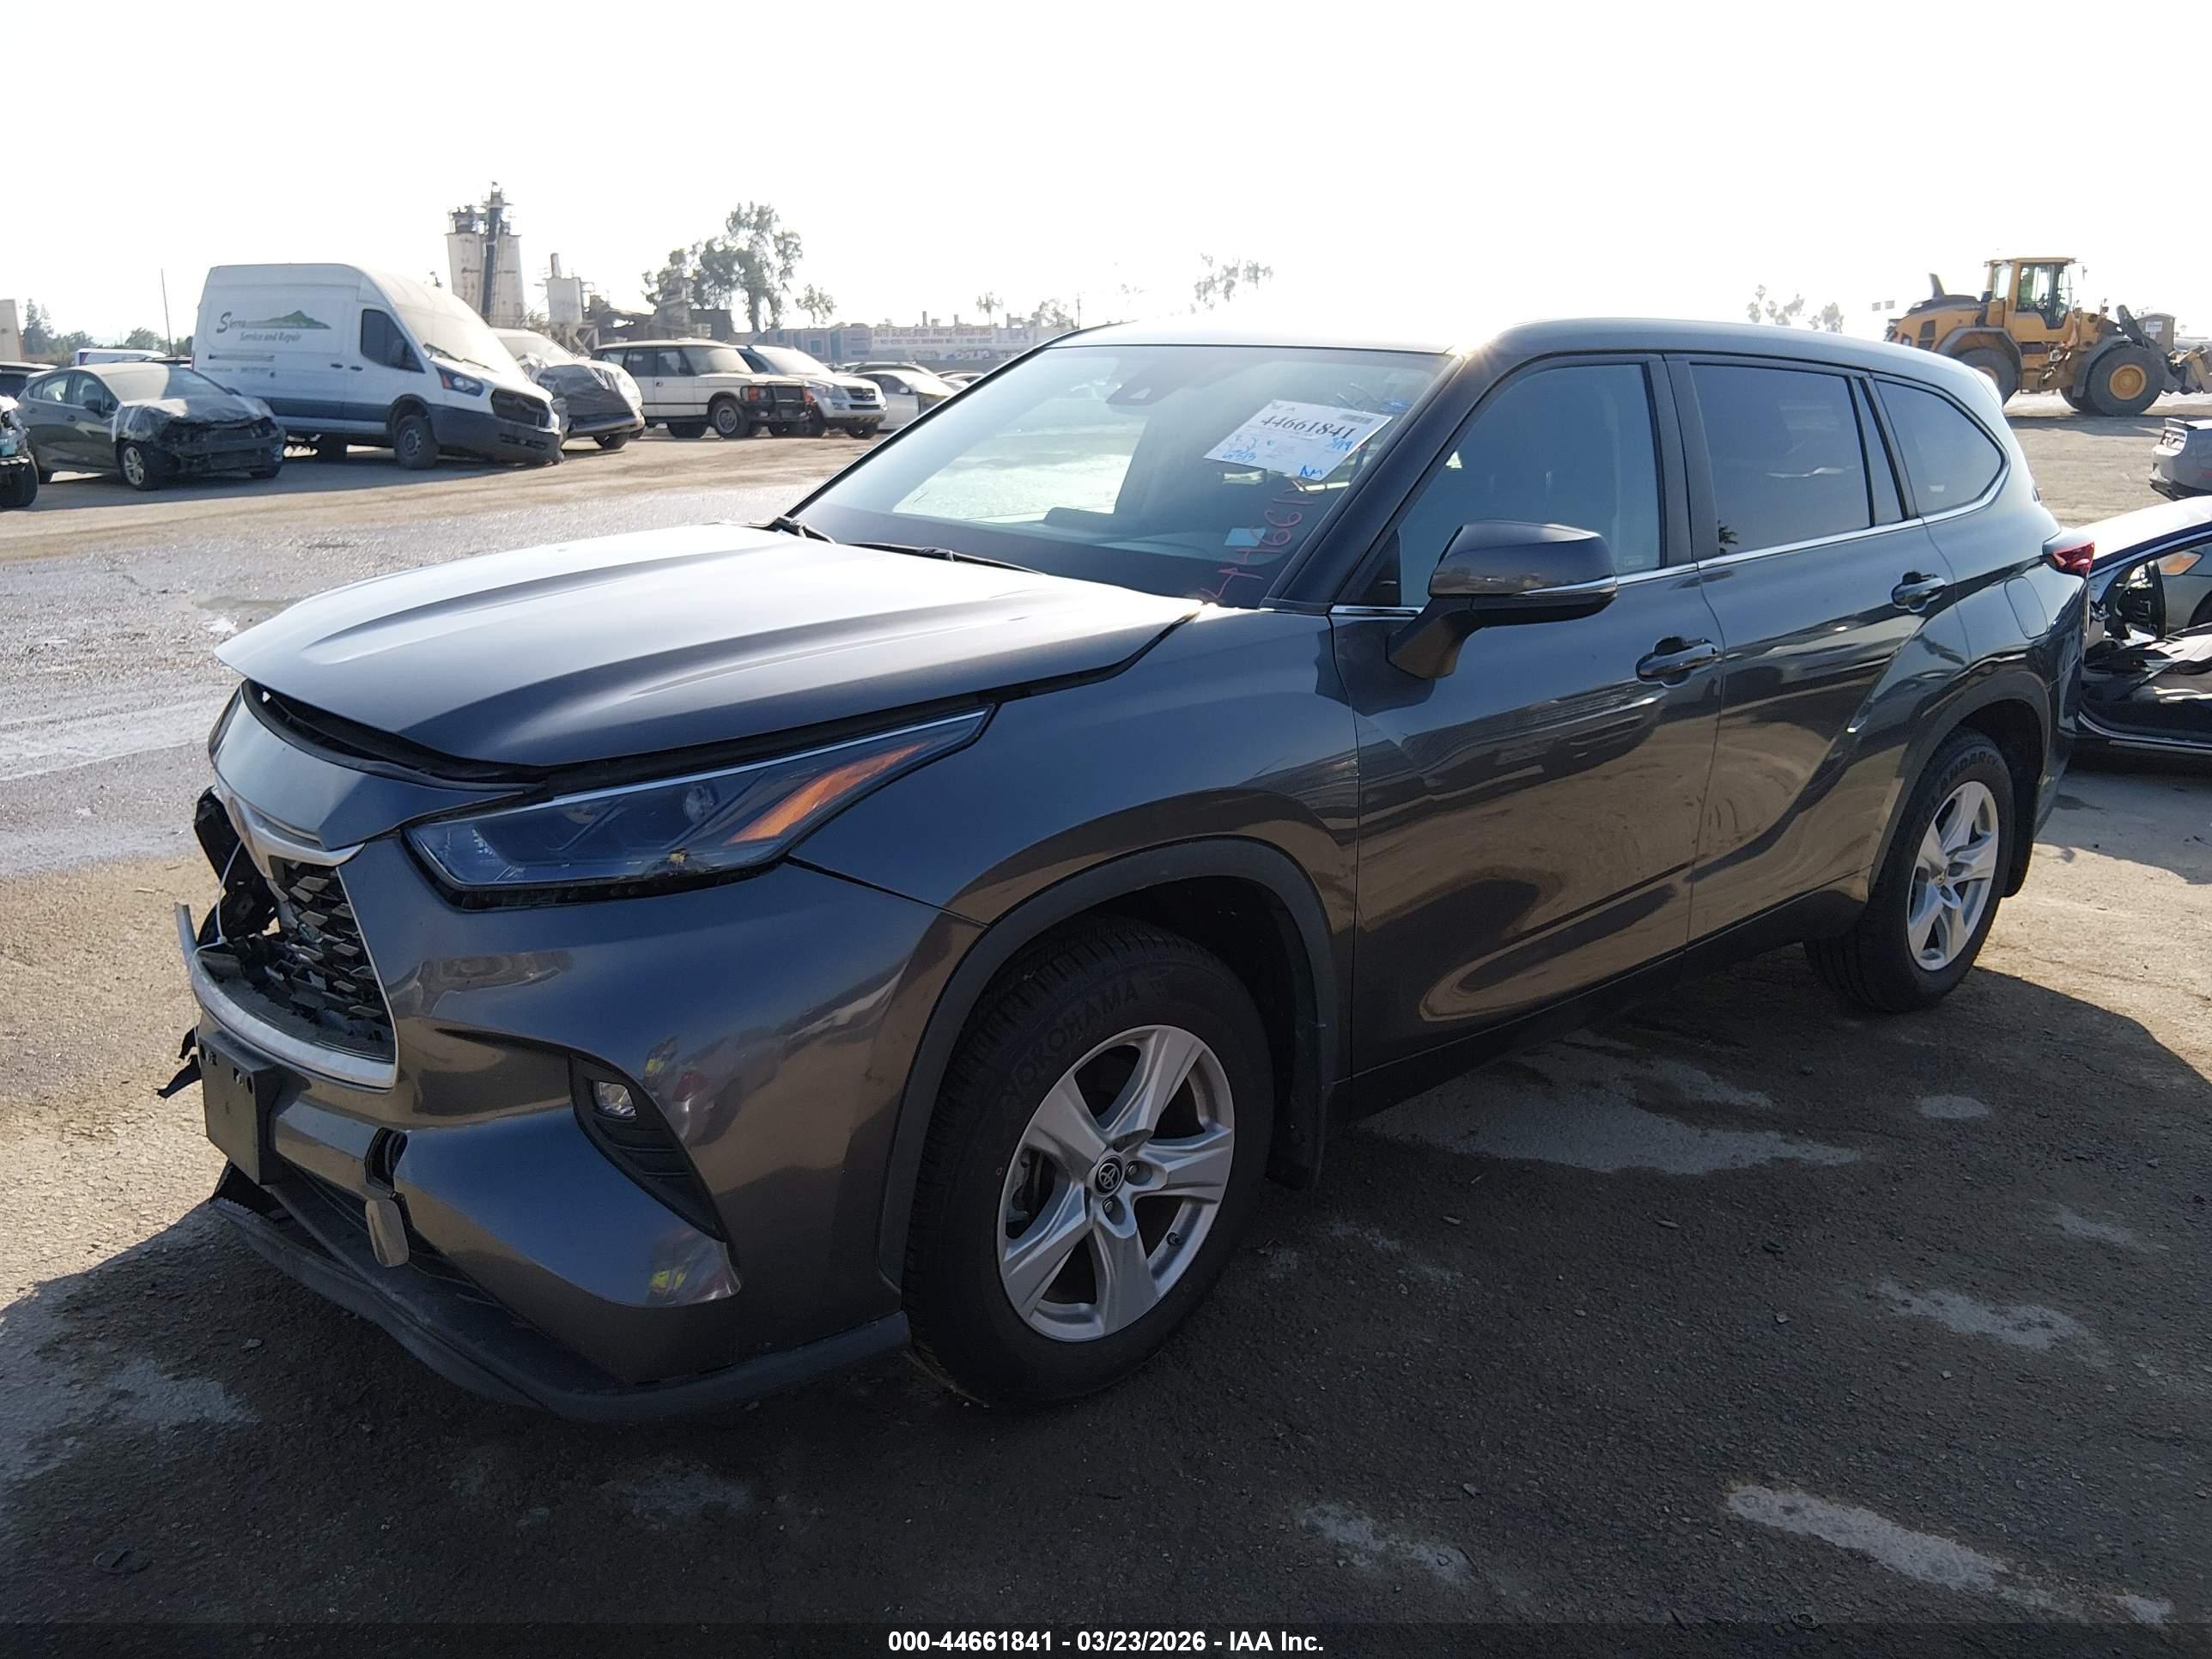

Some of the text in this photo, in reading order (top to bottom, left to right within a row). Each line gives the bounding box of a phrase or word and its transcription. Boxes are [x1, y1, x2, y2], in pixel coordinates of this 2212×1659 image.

[240, 331, 301, 343] Service and Repair
[1261, 415, 1357, 440] 44661841
[999, 976, 1142, 1104] YOKOHAMA
